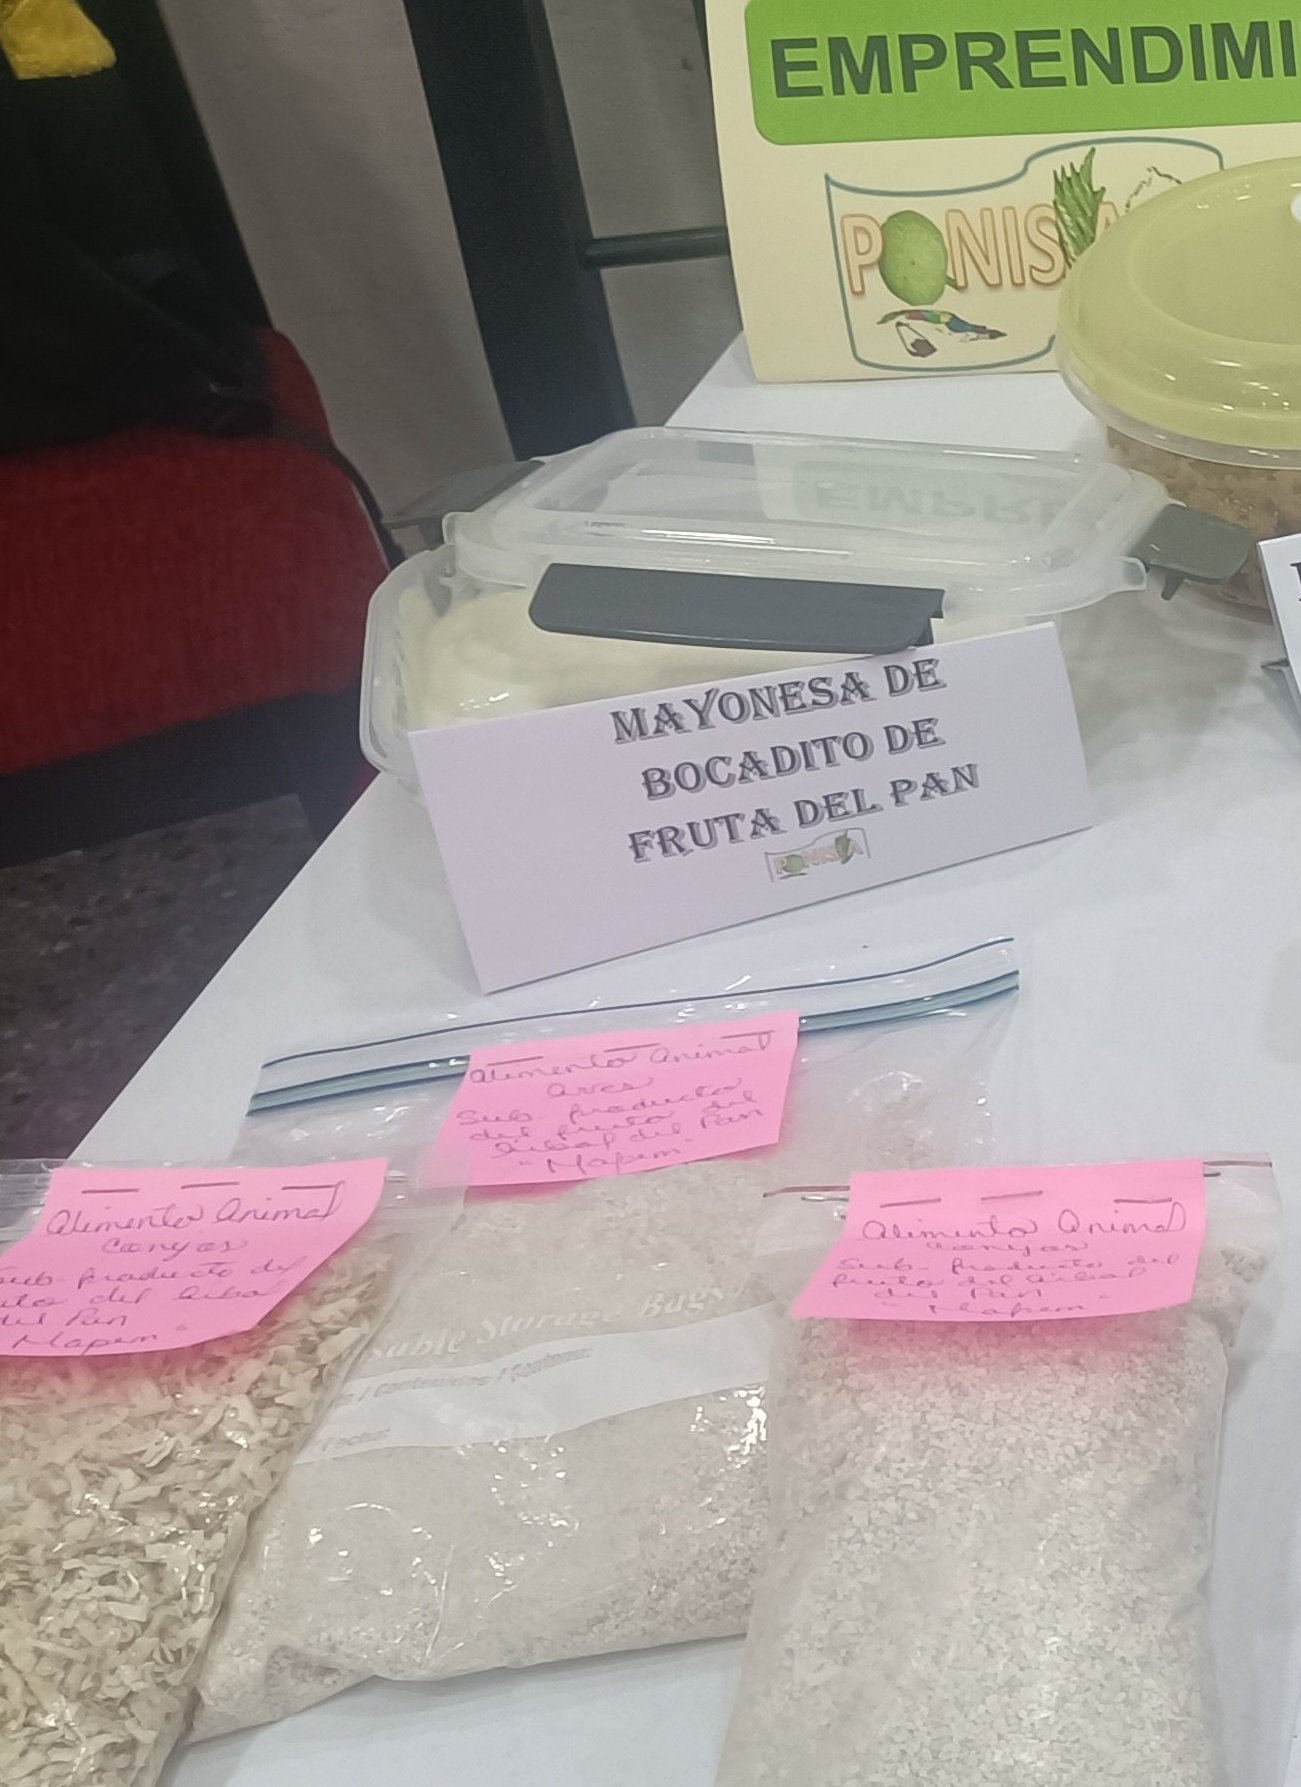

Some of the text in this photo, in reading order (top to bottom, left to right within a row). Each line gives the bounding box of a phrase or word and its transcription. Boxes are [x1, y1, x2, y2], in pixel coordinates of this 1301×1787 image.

[610, 657, 947, 745] MAYONESA DE
[641, 717, 946, 801] BOCADITO DE
[628, 763, 980, 864] FRUTA DEL PAN
